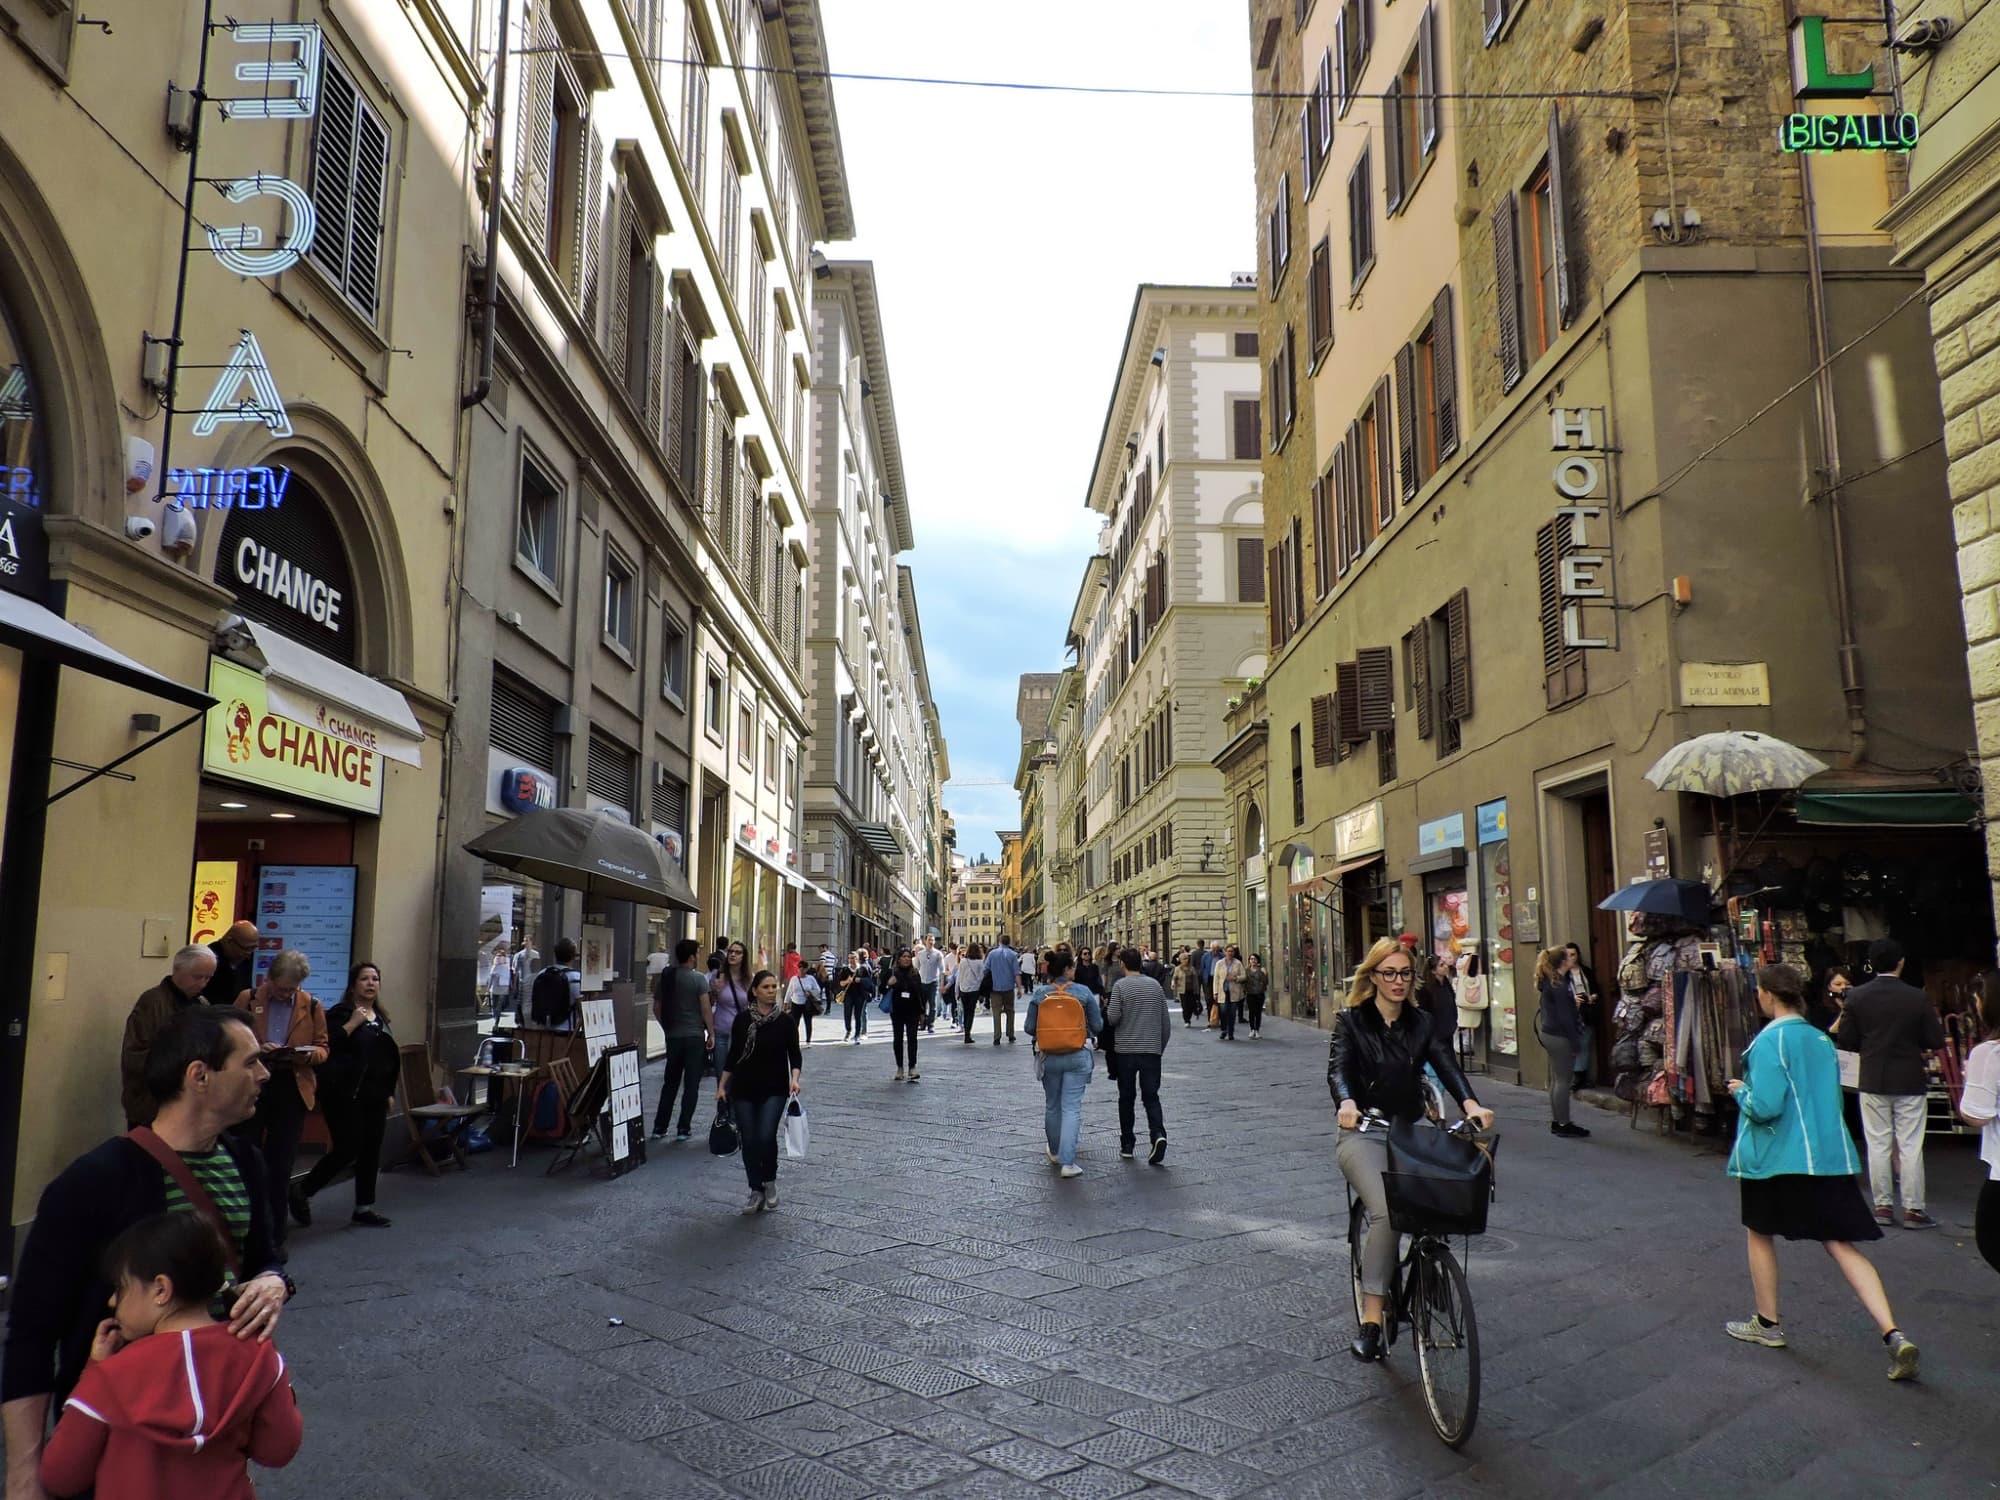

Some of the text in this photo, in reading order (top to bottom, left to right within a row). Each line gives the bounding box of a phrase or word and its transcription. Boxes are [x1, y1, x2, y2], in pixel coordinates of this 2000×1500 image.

[1787, 112, 1920, 149] BIGALLO
[1550, 408, 1609, 648] HOTEL
[237, 536, 342, 632] CHANGE
[1689, 687, 1718, 696] DEGLI
[328, 717, 378, 750] CHANGE
[258, 716, 375, 788] CHANGE
[535, 781, 552, 809] TIM
[598, 858, 636, 876] Caperlan
